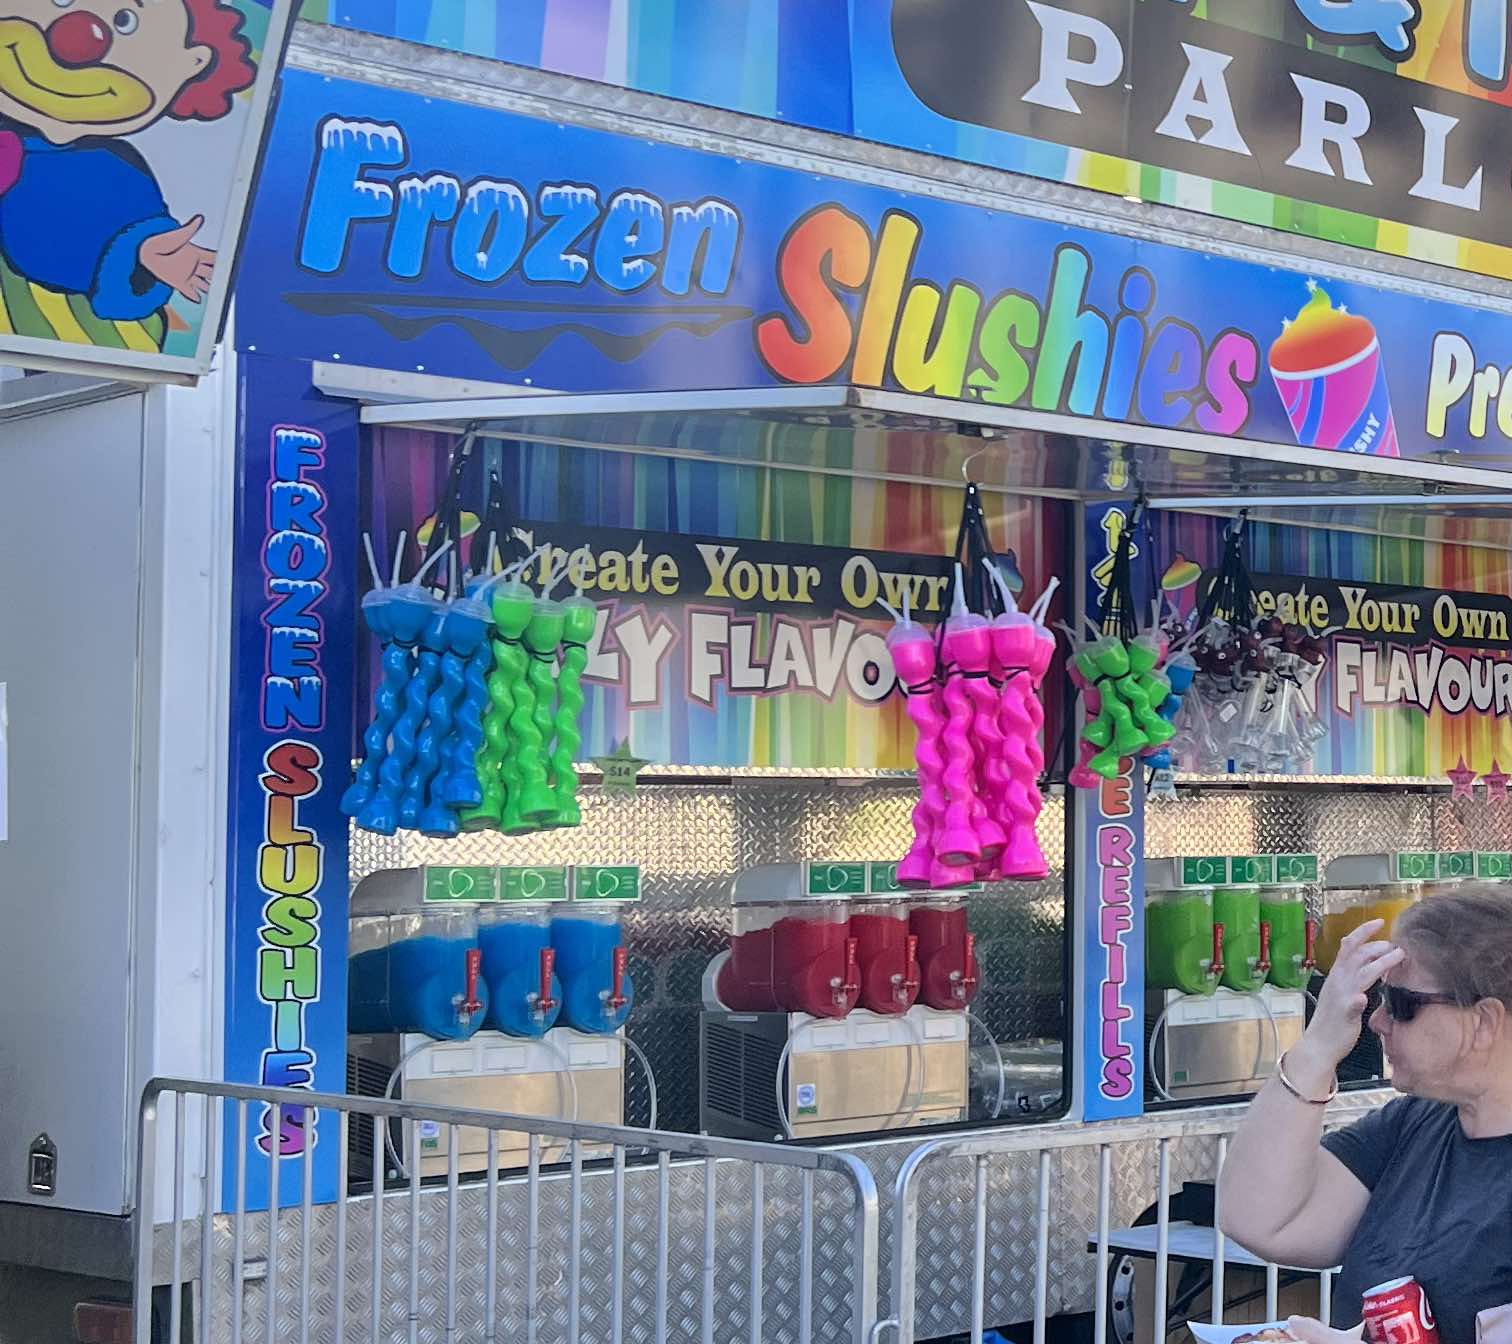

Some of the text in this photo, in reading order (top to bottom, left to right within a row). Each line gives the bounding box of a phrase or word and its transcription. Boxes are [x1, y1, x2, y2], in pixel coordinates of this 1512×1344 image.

[298, 116, 741, 296] Frozen
[756, 204, 1258, 437] Slushies
[695, 543, 821, 604] Your
[1338, 585, 1421, 634] Your
[1431, 594, 1511, 642] Own
[258, 428, 328, 1155] FROZEN SLUSHIES
[1098, 825, 1135, 1099] REFILLS
